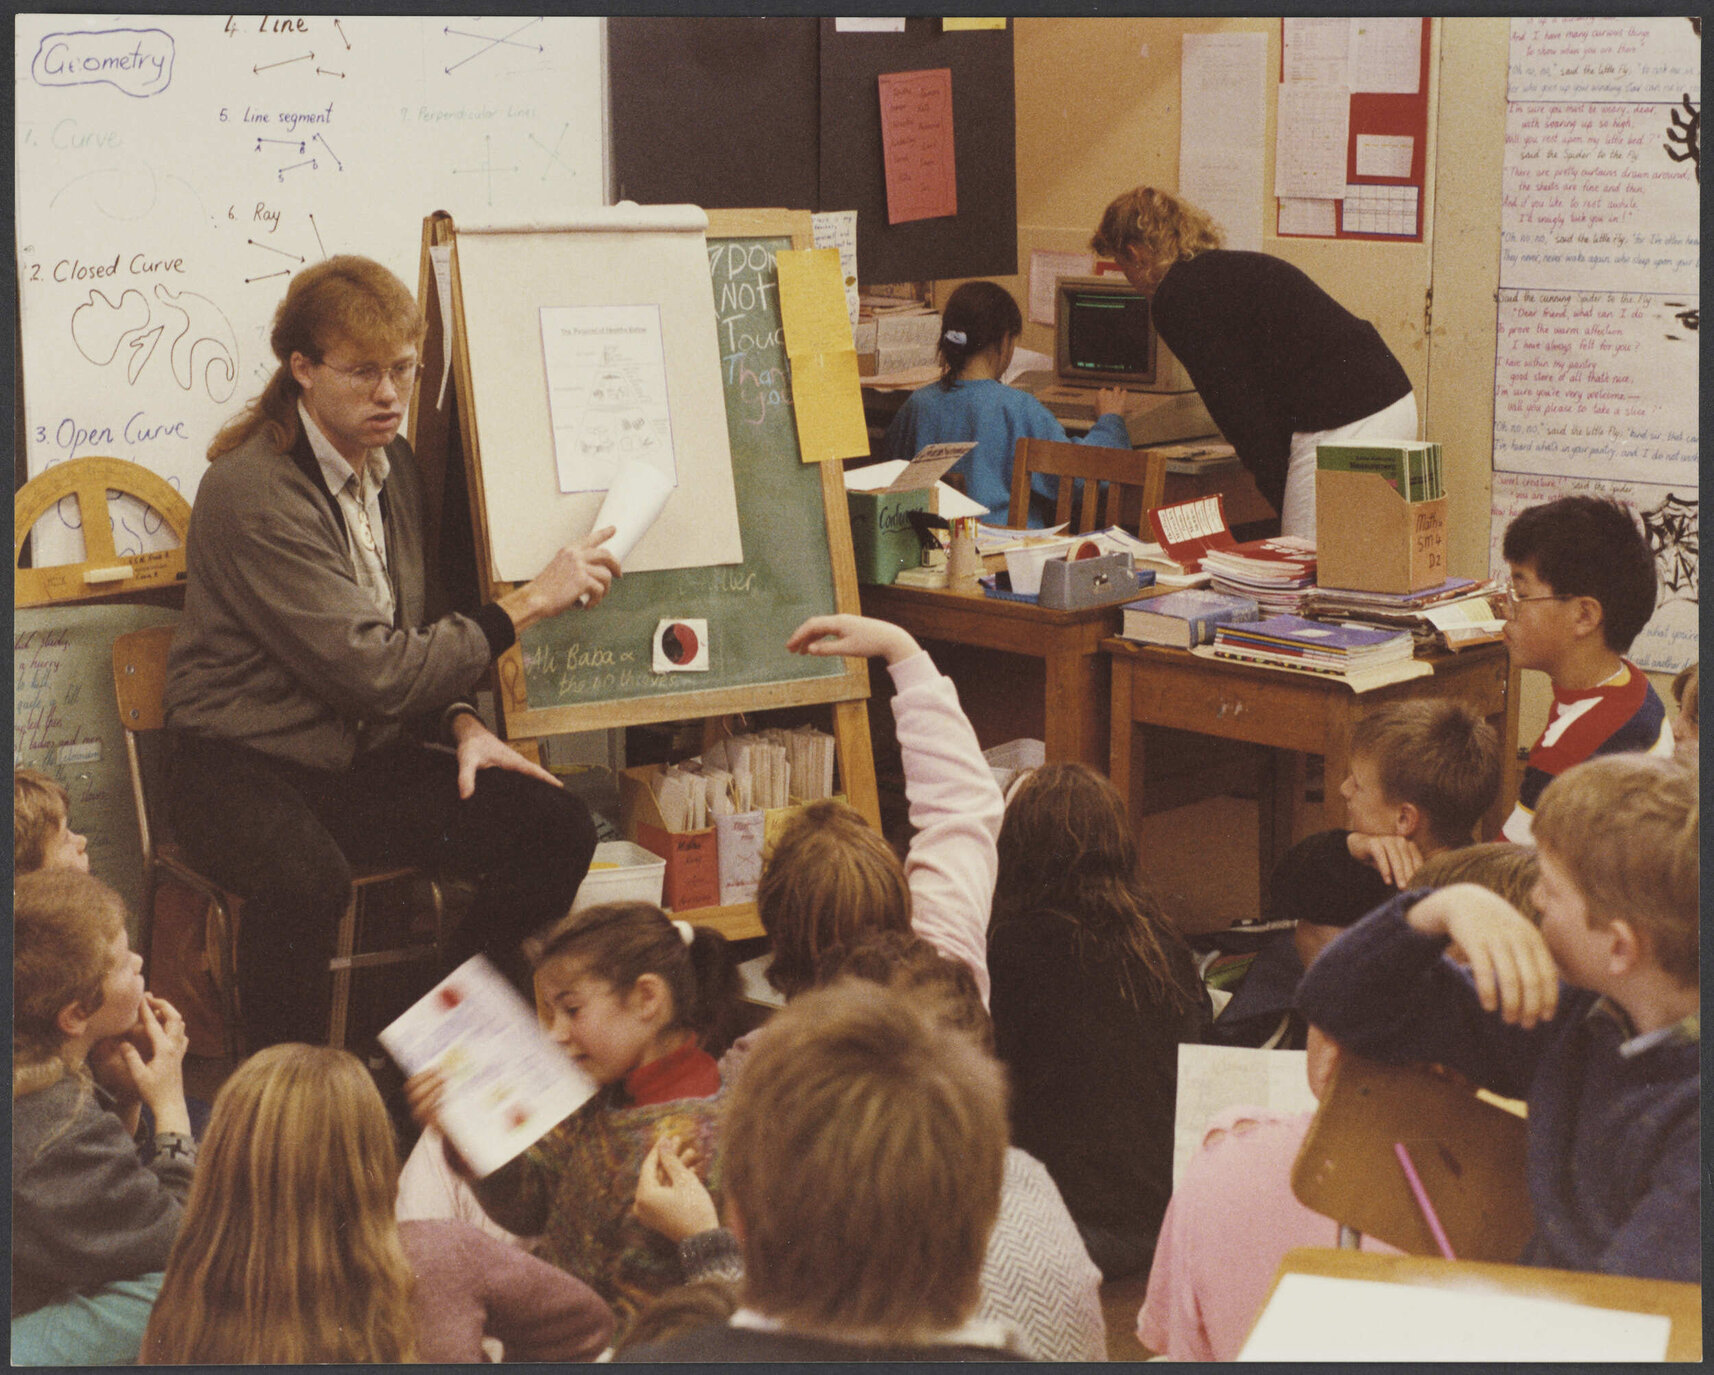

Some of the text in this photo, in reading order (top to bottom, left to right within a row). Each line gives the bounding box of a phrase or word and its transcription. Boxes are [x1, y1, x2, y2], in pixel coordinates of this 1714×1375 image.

[44, 41, 166, 86] Geometry
[243, 106, 270, 123] Line
[278, 102, 333, 133] segment
[1549, 106, 1562, 118] you
[1582, 120, 1592, 130] up
[50, 117, 123, 150] Curve
[253, 202, 282, 232] Ray
[1590, 215, 1603, 228] you
[1555, 235, 1573, 243] said
[53, 255, 120, 283] Closed
[129, 254, 187, 276] Curve
[722, 314, 784, 354] Touc
[56, 418, 114, 459] Open
[124, 412, 191, 445] Curve
[1547, 425, 1566, 435] said
[566, 643, 616, 671] Baba
